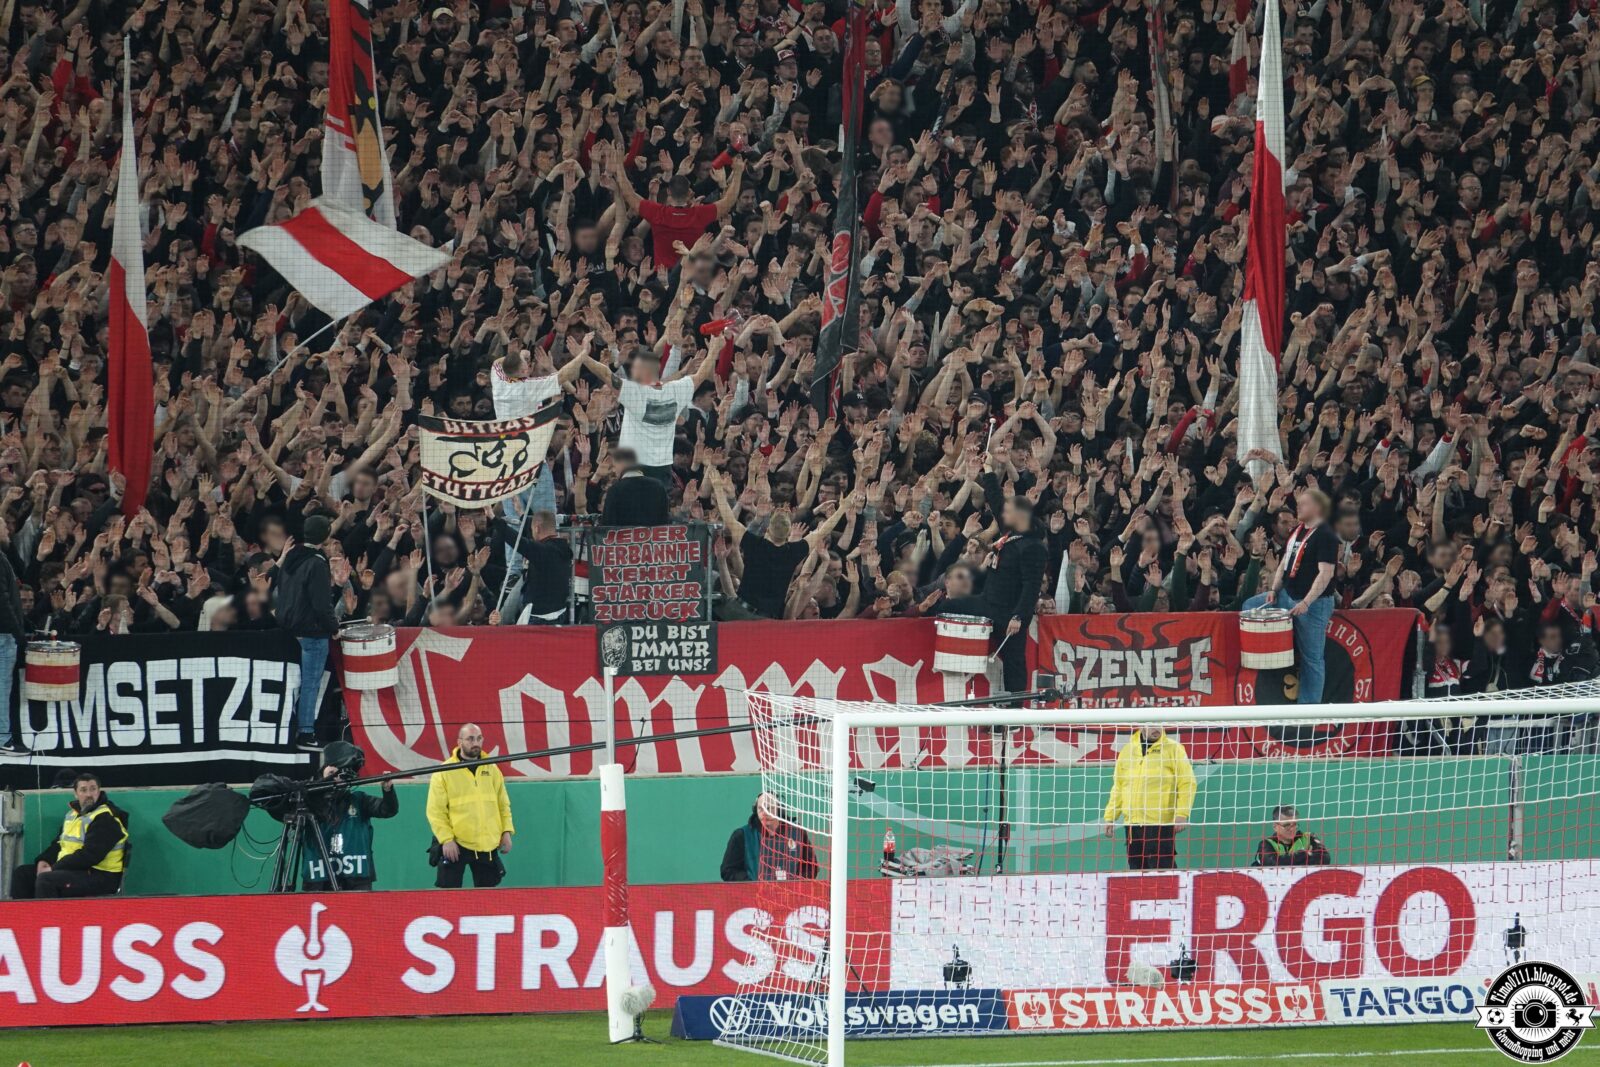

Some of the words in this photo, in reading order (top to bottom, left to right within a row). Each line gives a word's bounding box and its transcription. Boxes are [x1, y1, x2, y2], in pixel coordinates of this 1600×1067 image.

[444, 417, 535, 433] ULTRAS
[422, 466, 539, 499] STUTTGART
[604, 525, 687, 545] JEDER
[591, 541, 700, 566] VERBANNTE
[602, 563, 691, 583] KEHRT
[595, 600, 700, 621] ZURÜCK
[631, 625, 658, 640] DU
[667, 624, 710, 640] BIST
[631, 641, 711, 658] IMMER
[632, 659, 660, 672] BEI
[668, 658, 711, 672] UNS!
[1053, 639, 1178, 694] SZENE
[1190, 636, 1212, 695] E
[1237, 683, 1254, 703] 19
[1355, 678, 1372, 700] 97
[309, 855, 367, 879] HOST
[1105, 867, 1477, 986] ERGO
[401, 906, 831, 994] STRAUSS
[766, 1001, 980, 1030] Volswagen
[1059, 988, 1273, 1027] STRAUSS
